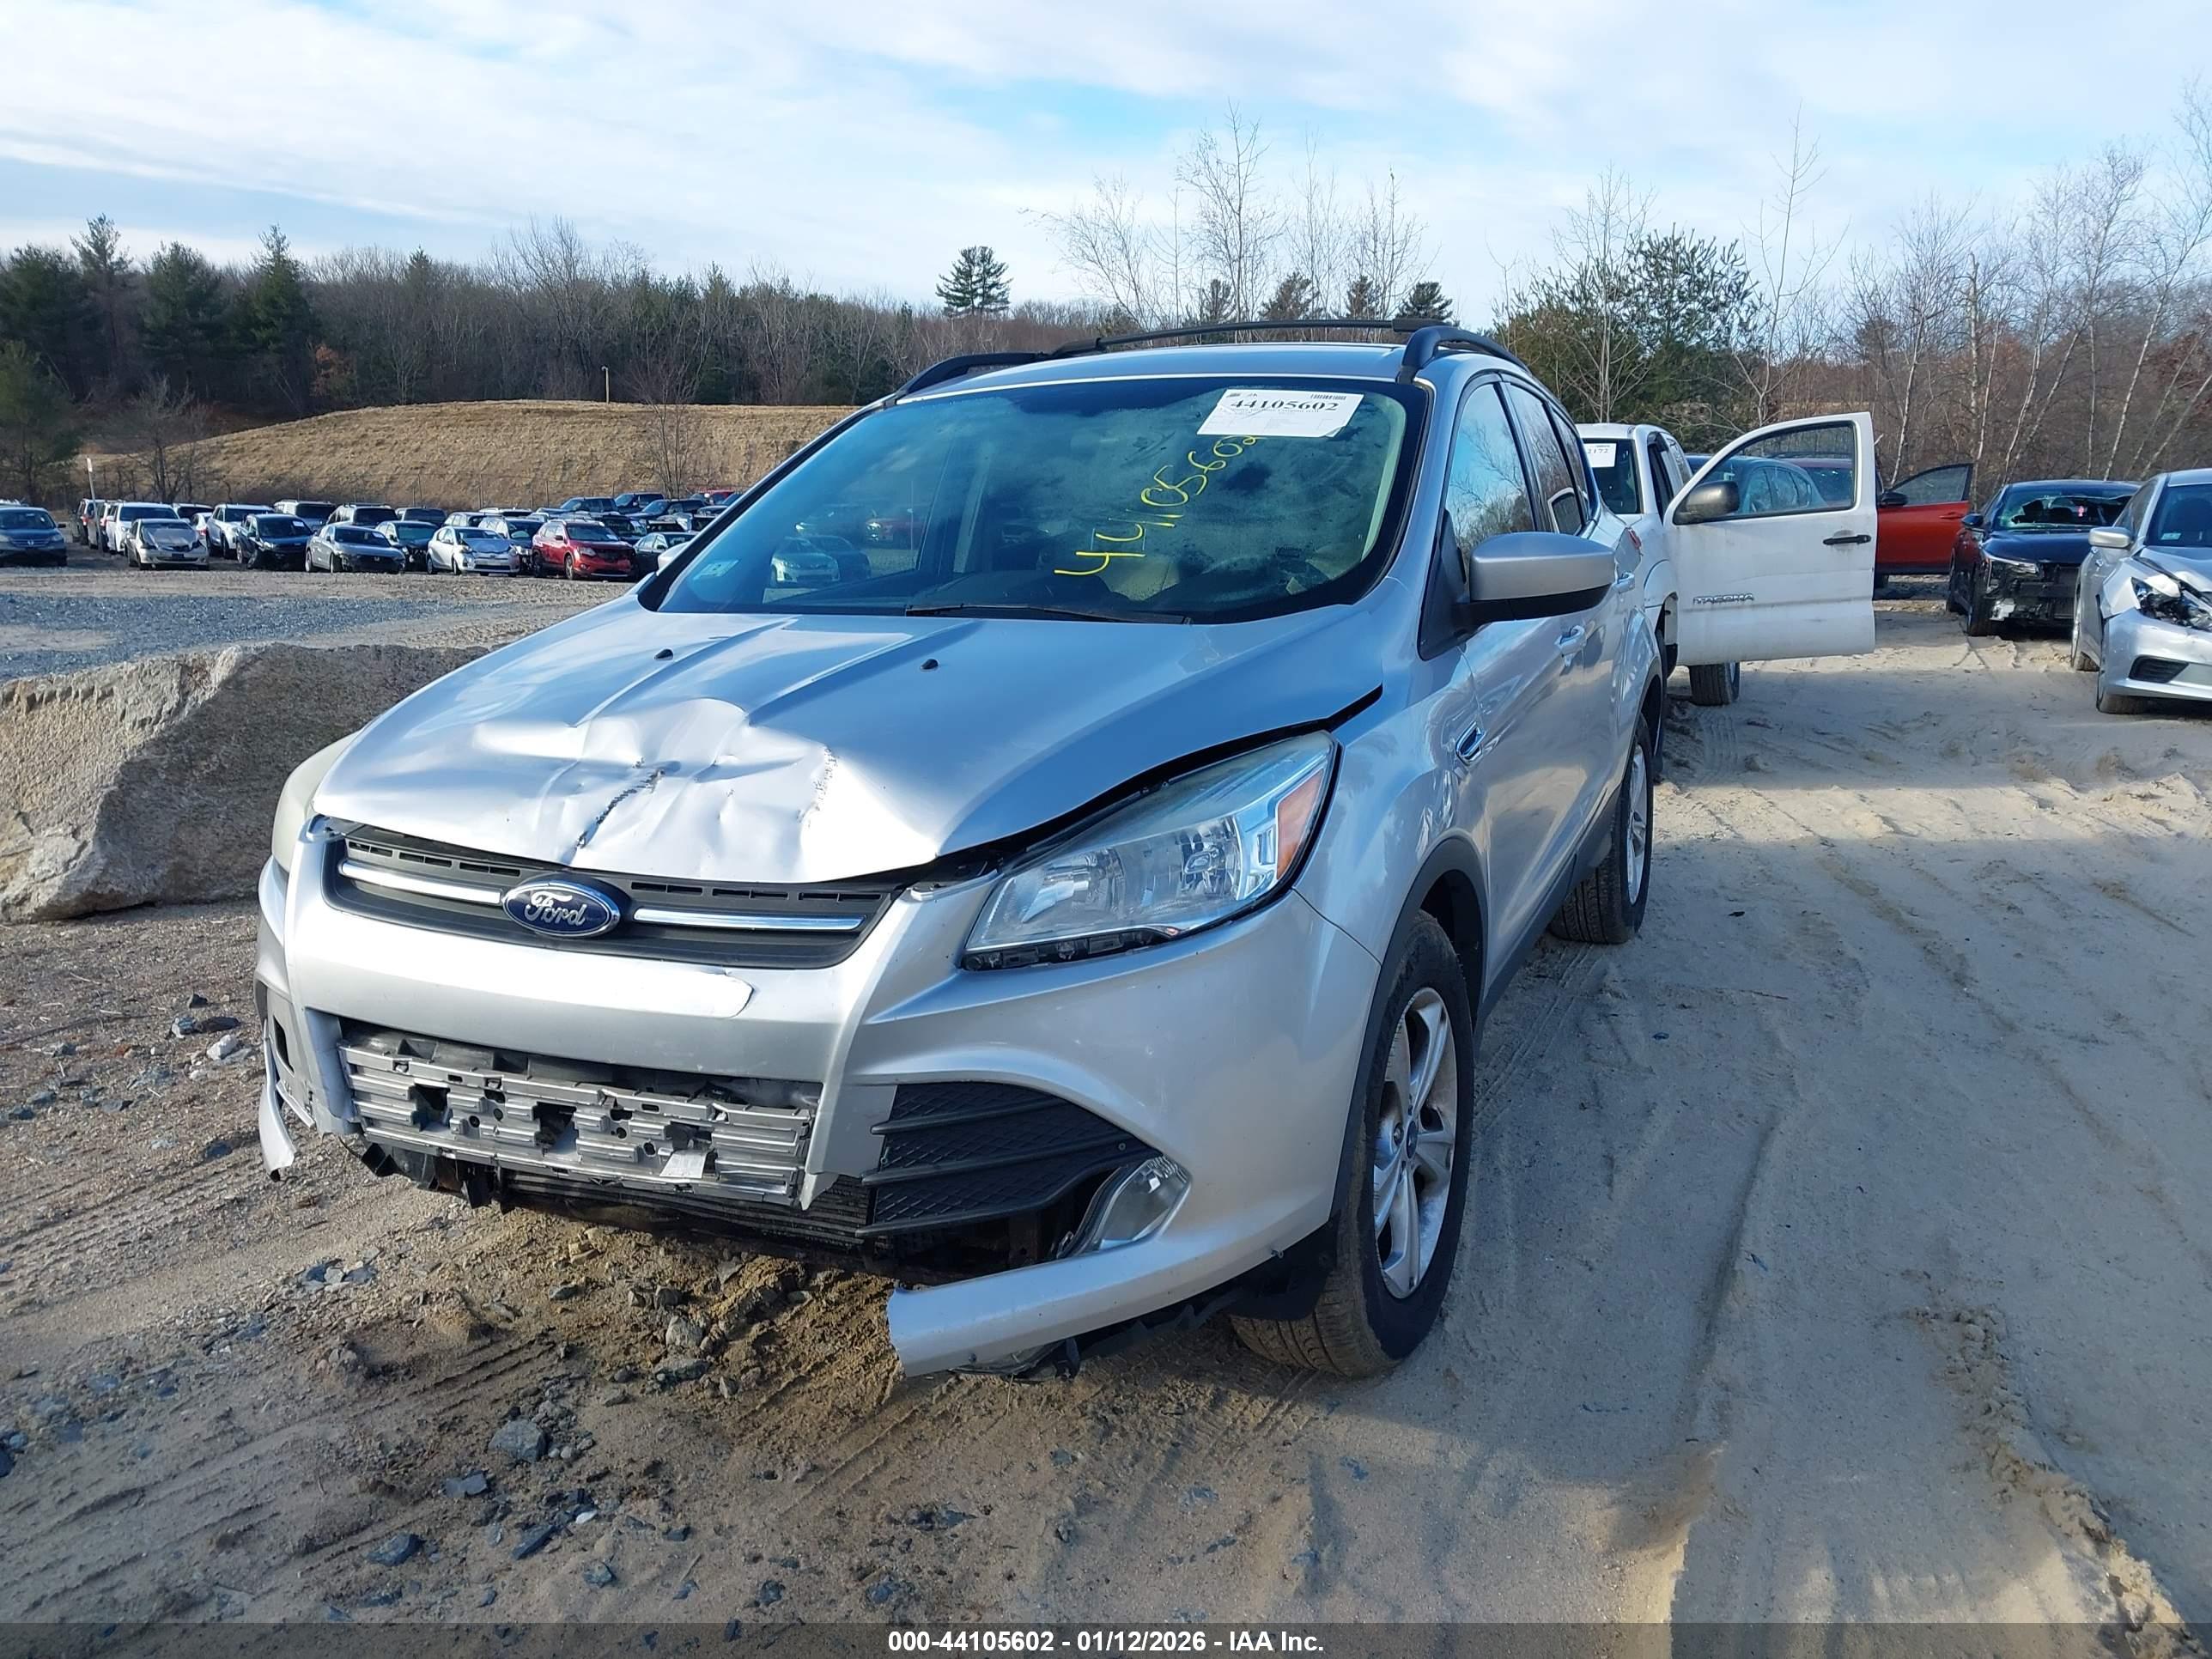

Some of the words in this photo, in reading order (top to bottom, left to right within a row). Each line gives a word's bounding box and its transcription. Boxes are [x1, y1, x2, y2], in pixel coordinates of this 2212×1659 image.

[1231, 398, 1340, 412] 44105602
[1692, 593, 1754, 605] TACOMA
[524, 890, 587, 927] Ford
